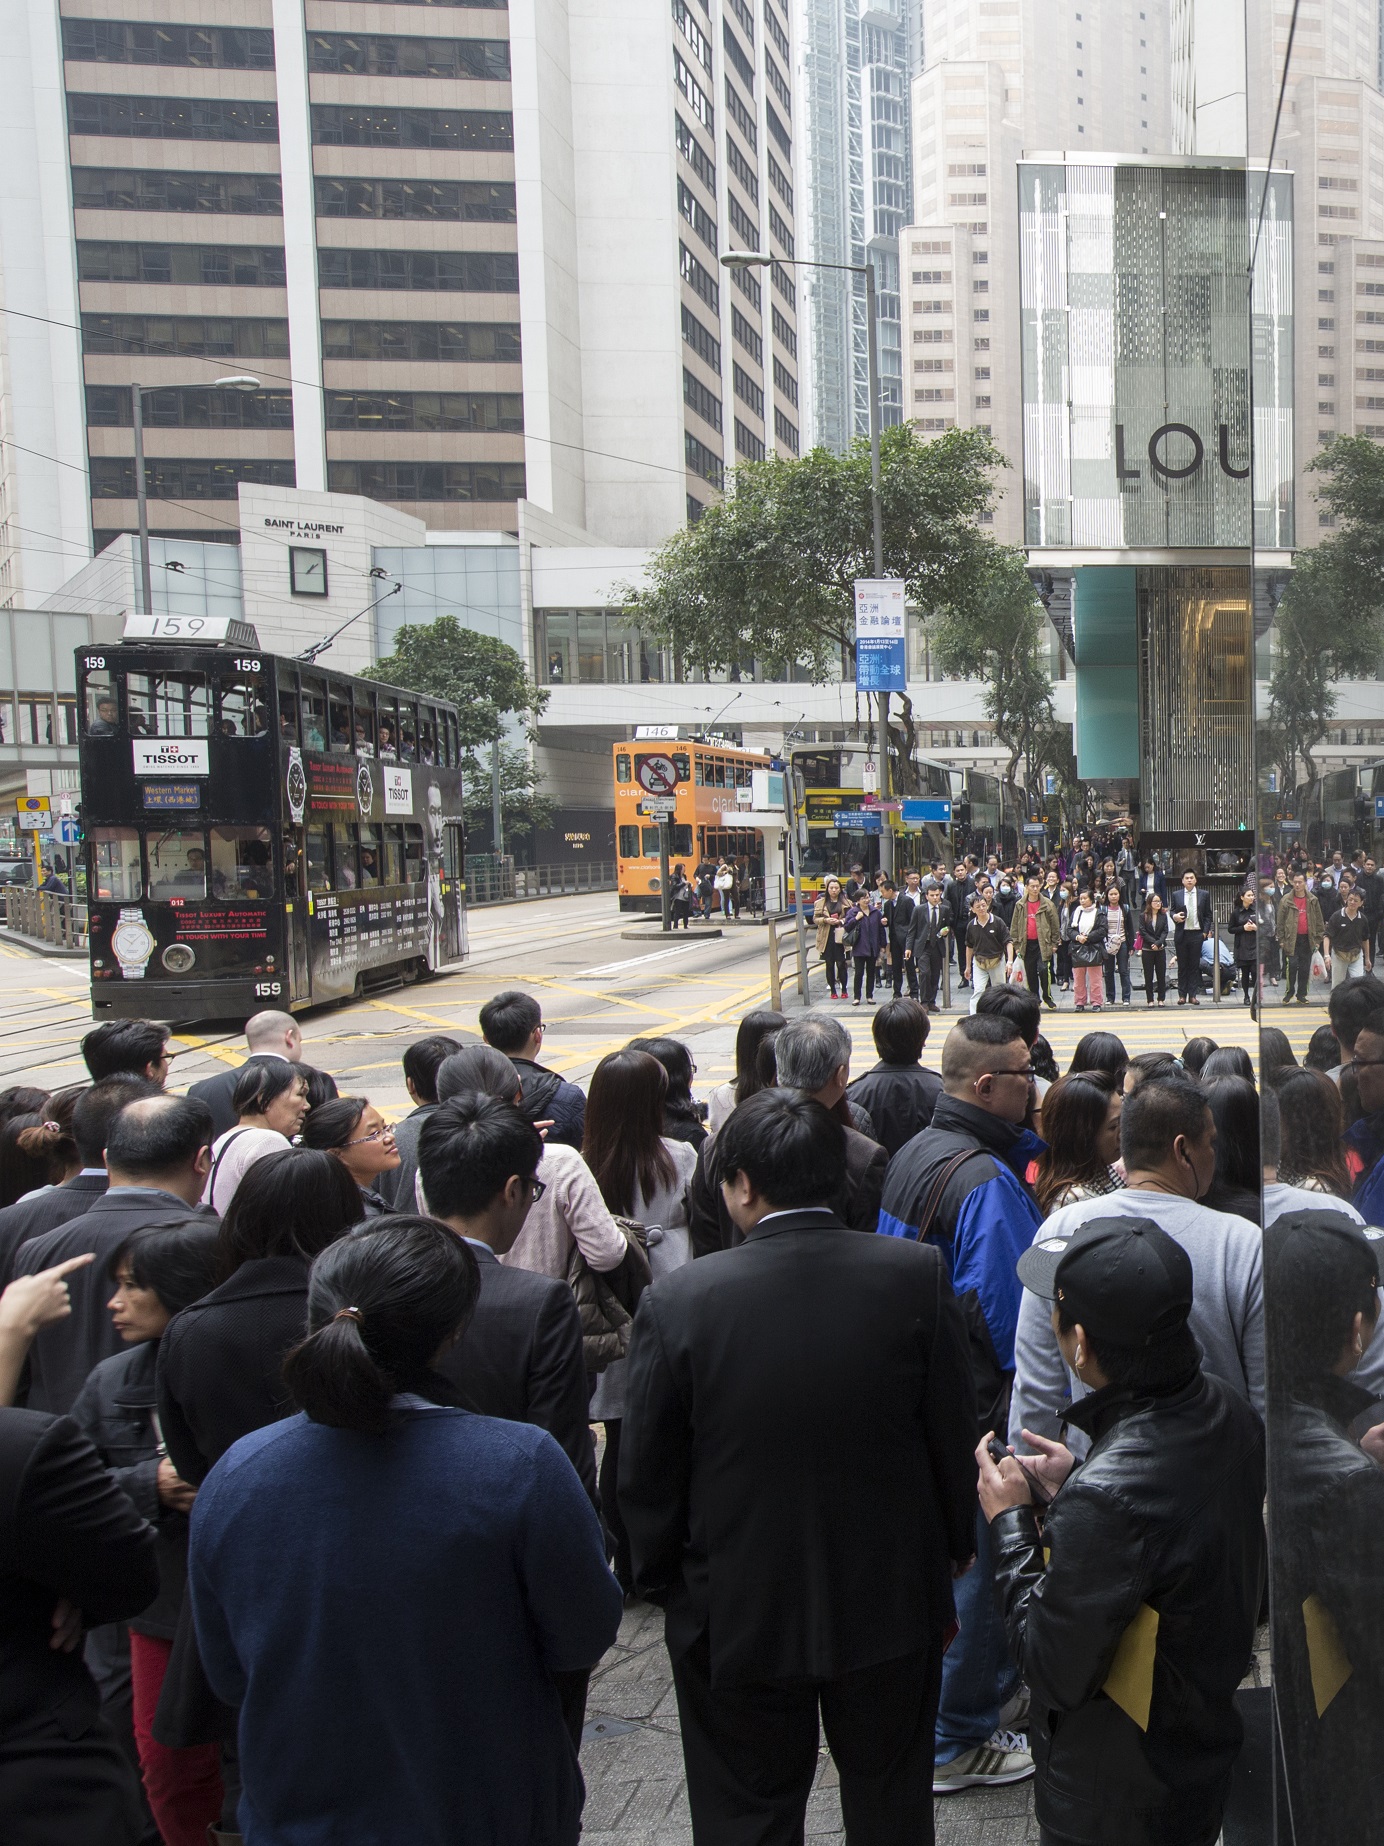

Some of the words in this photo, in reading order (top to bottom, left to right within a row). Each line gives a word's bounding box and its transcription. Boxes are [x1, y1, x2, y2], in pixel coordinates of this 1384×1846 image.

[1115, 422, 1250, 478] LOU
[264, 518, 294, 529] SAINT
[298, 522, 344, 534] LAURENT
[290, 531, 321, 540] PARIS
[858, 603, 879, 614] 亞洲
[151, 617, 205, 636] 159
[859, 615, 902, 626] 金融論壇
[84, 656, 106, 669] 159
[234, 659, 261, 672] 159
[858, 664, 902, 676] 帶動全球
[858, 675, 880, 686] 增長
[645, 726, 669, 736] 146
[143, 754, 198, 764] TISSOT
[389, 788, 408, 800] TISSOT
[255, 982, 282, 996] 159
